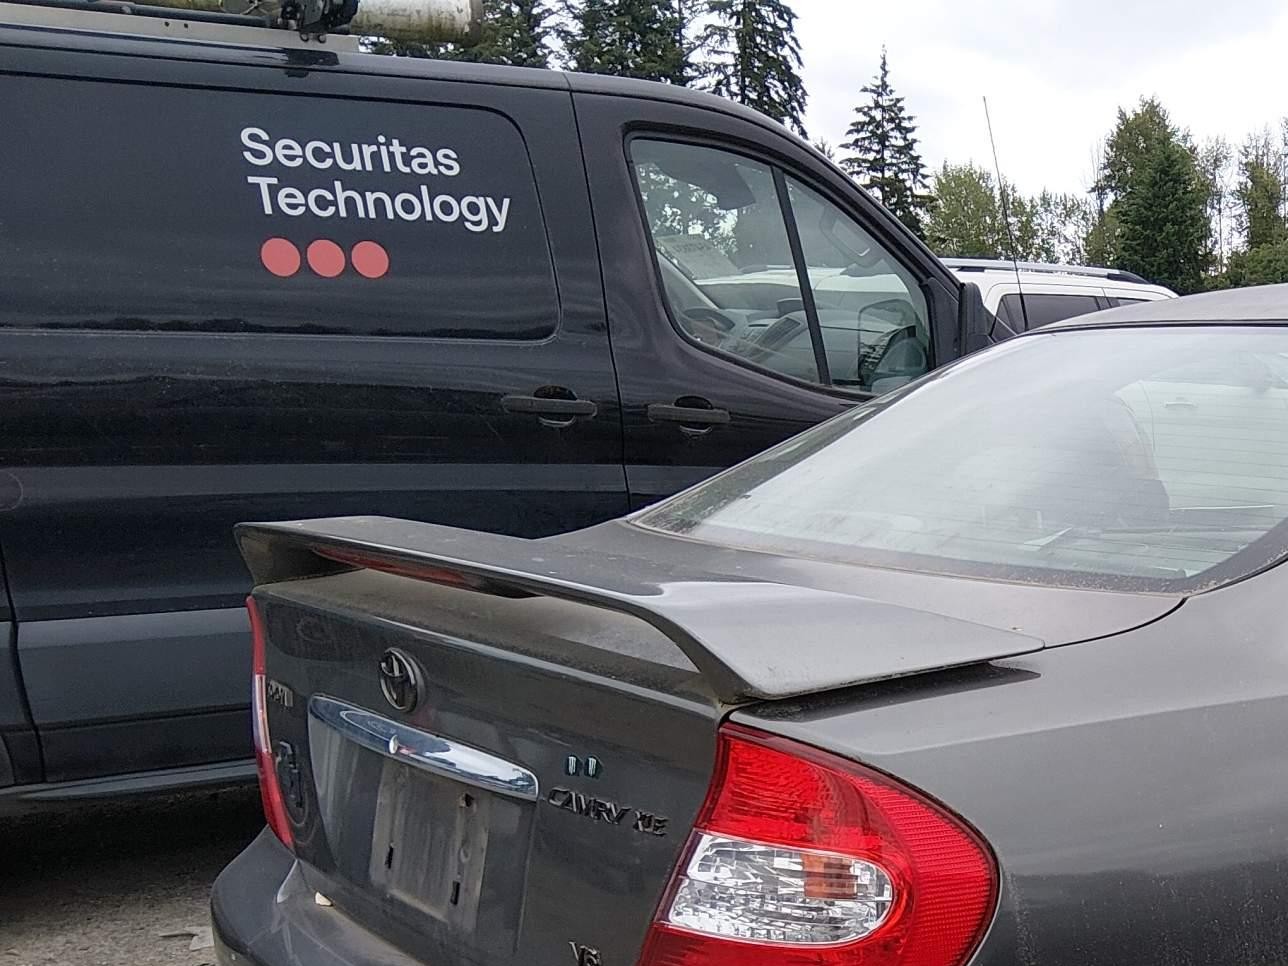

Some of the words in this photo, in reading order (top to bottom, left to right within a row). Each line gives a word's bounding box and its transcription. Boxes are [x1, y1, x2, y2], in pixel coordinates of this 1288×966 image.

[240, 127, 461, 176] Securitas
[247, 175, 511, 233] Technology
[548, 786, 631, 825] CAMRY
